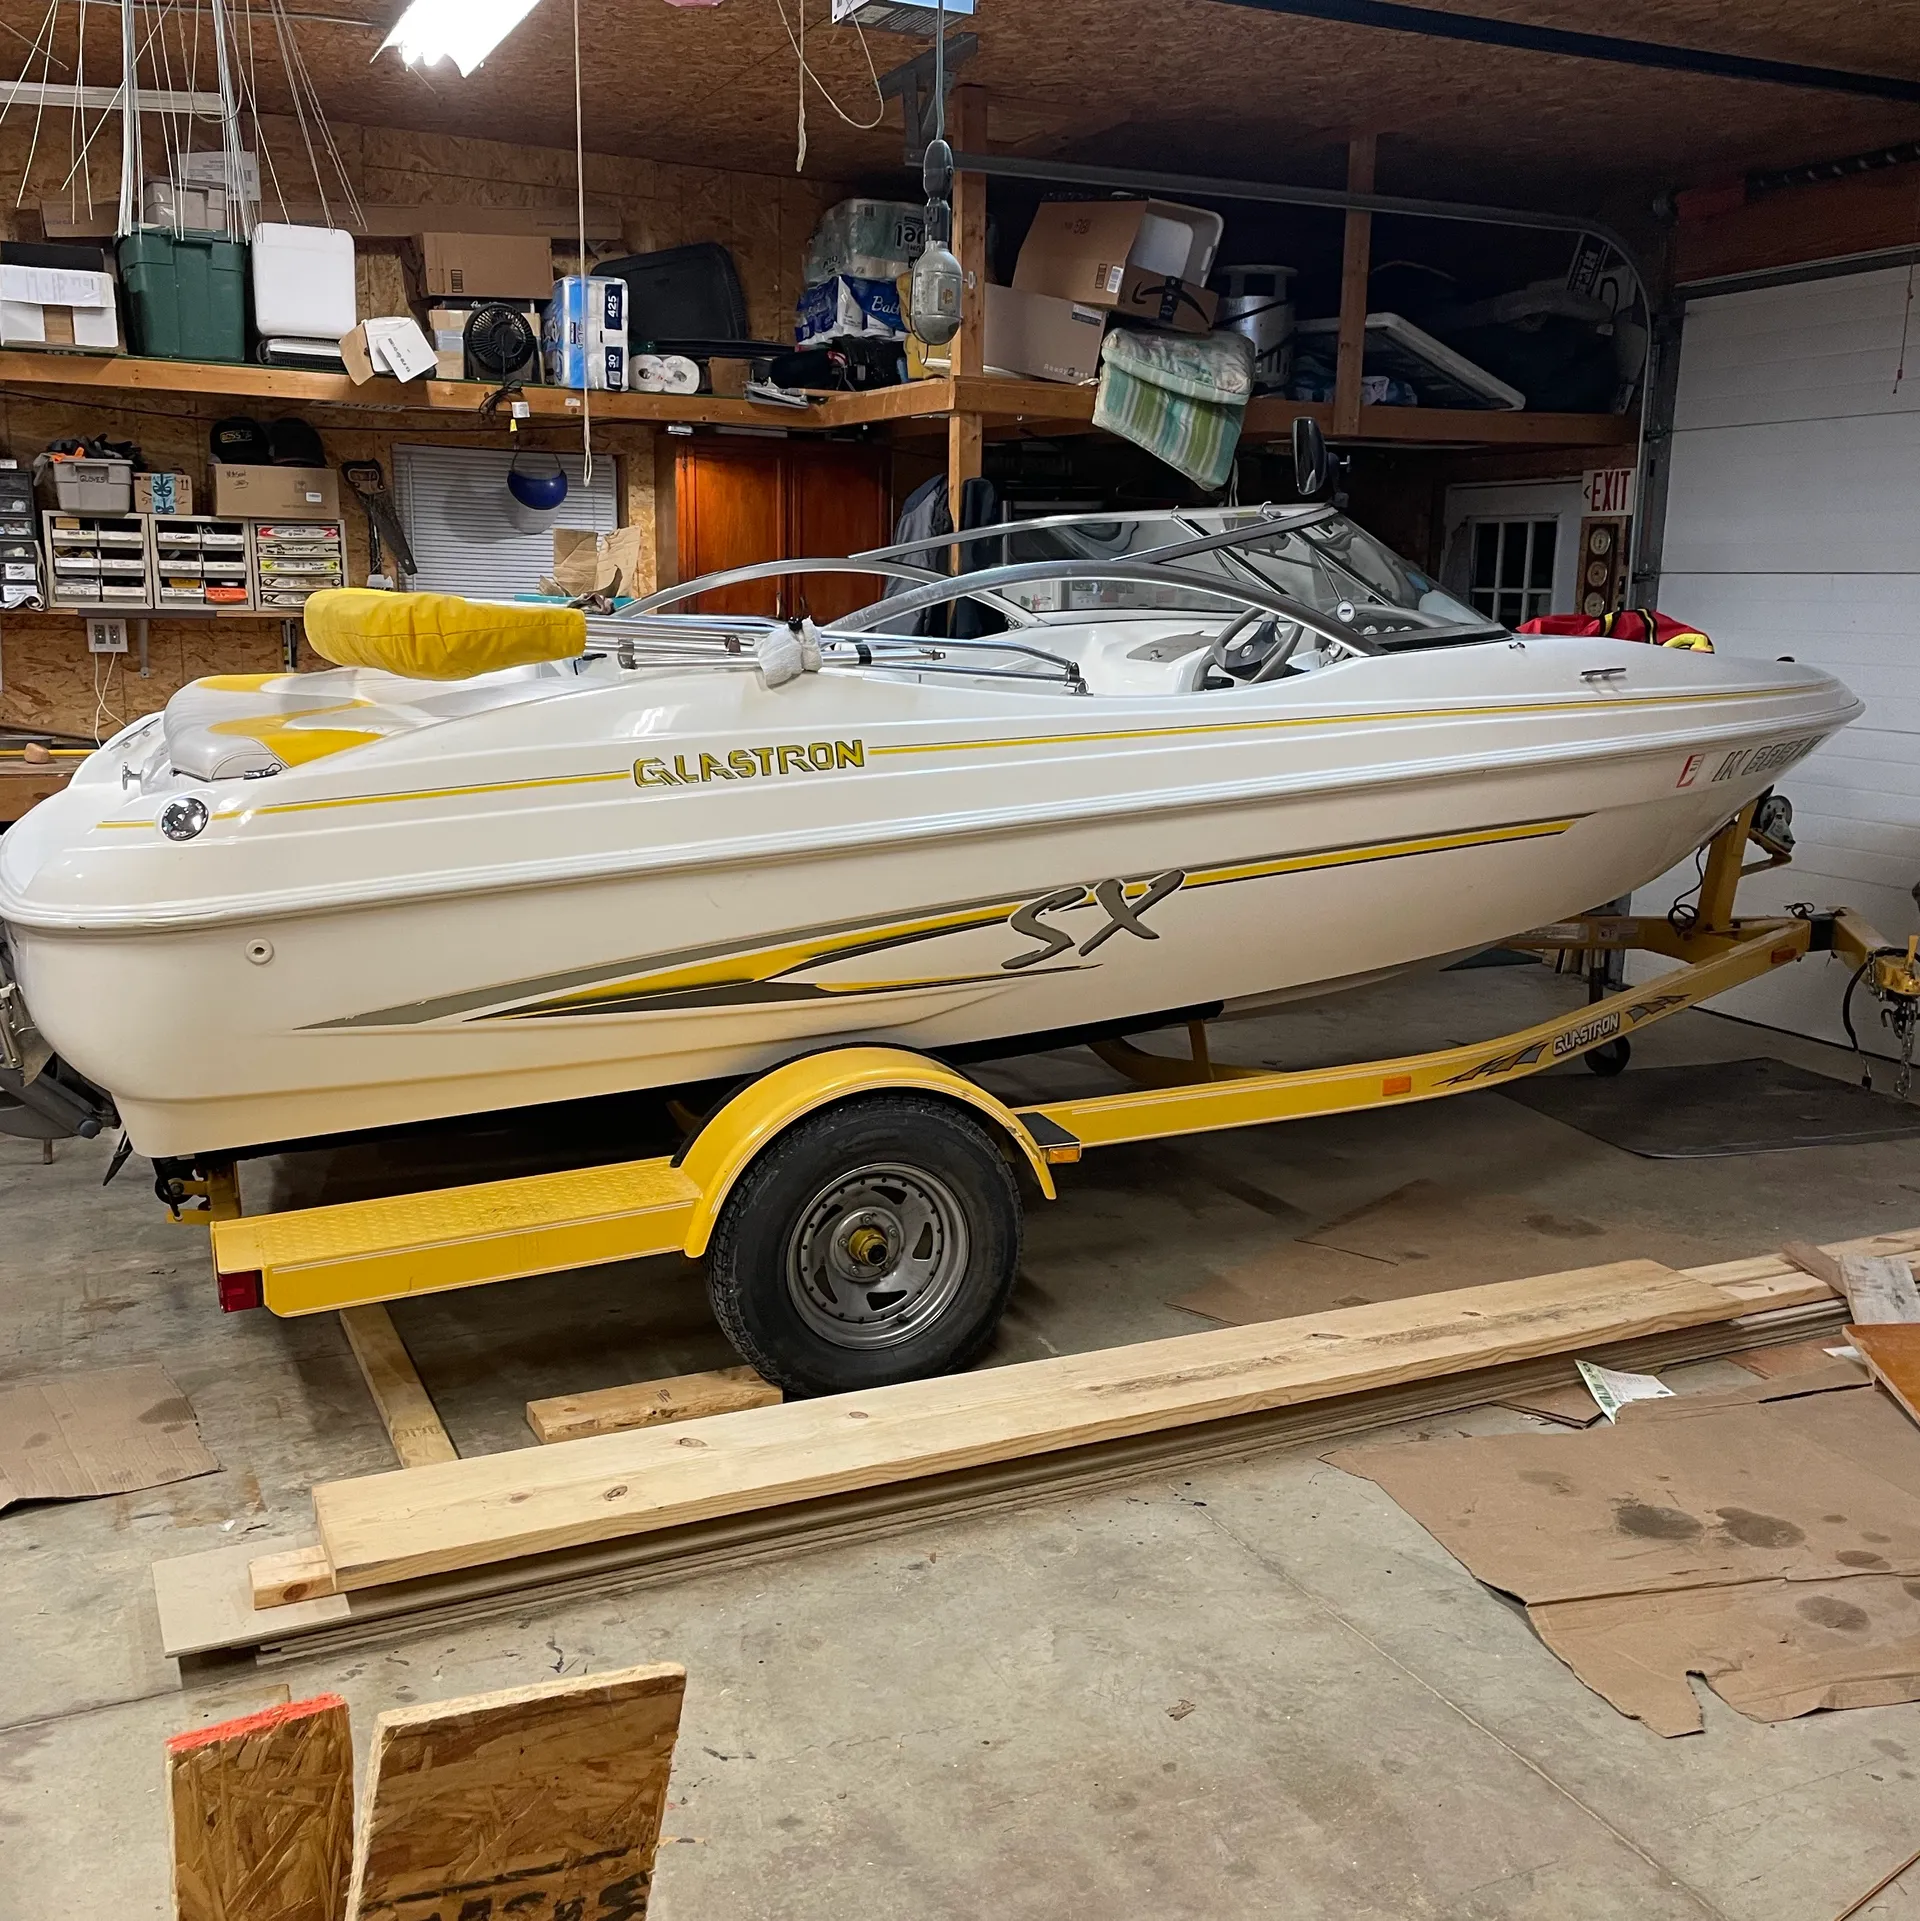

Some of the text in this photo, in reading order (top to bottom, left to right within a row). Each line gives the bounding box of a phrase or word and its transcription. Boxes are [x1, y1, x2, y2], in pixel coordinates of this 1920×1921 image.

[607, 295, 617, 318] 425
[608, 354, 616, 369] 30
[1591, 470, 1631, 512] EXIT
[633, 739, 865, 788] GLASTRON
[1001, 869, 1186, 970] SX
[1553, 1012, 1621, 1056] GLASTRON
